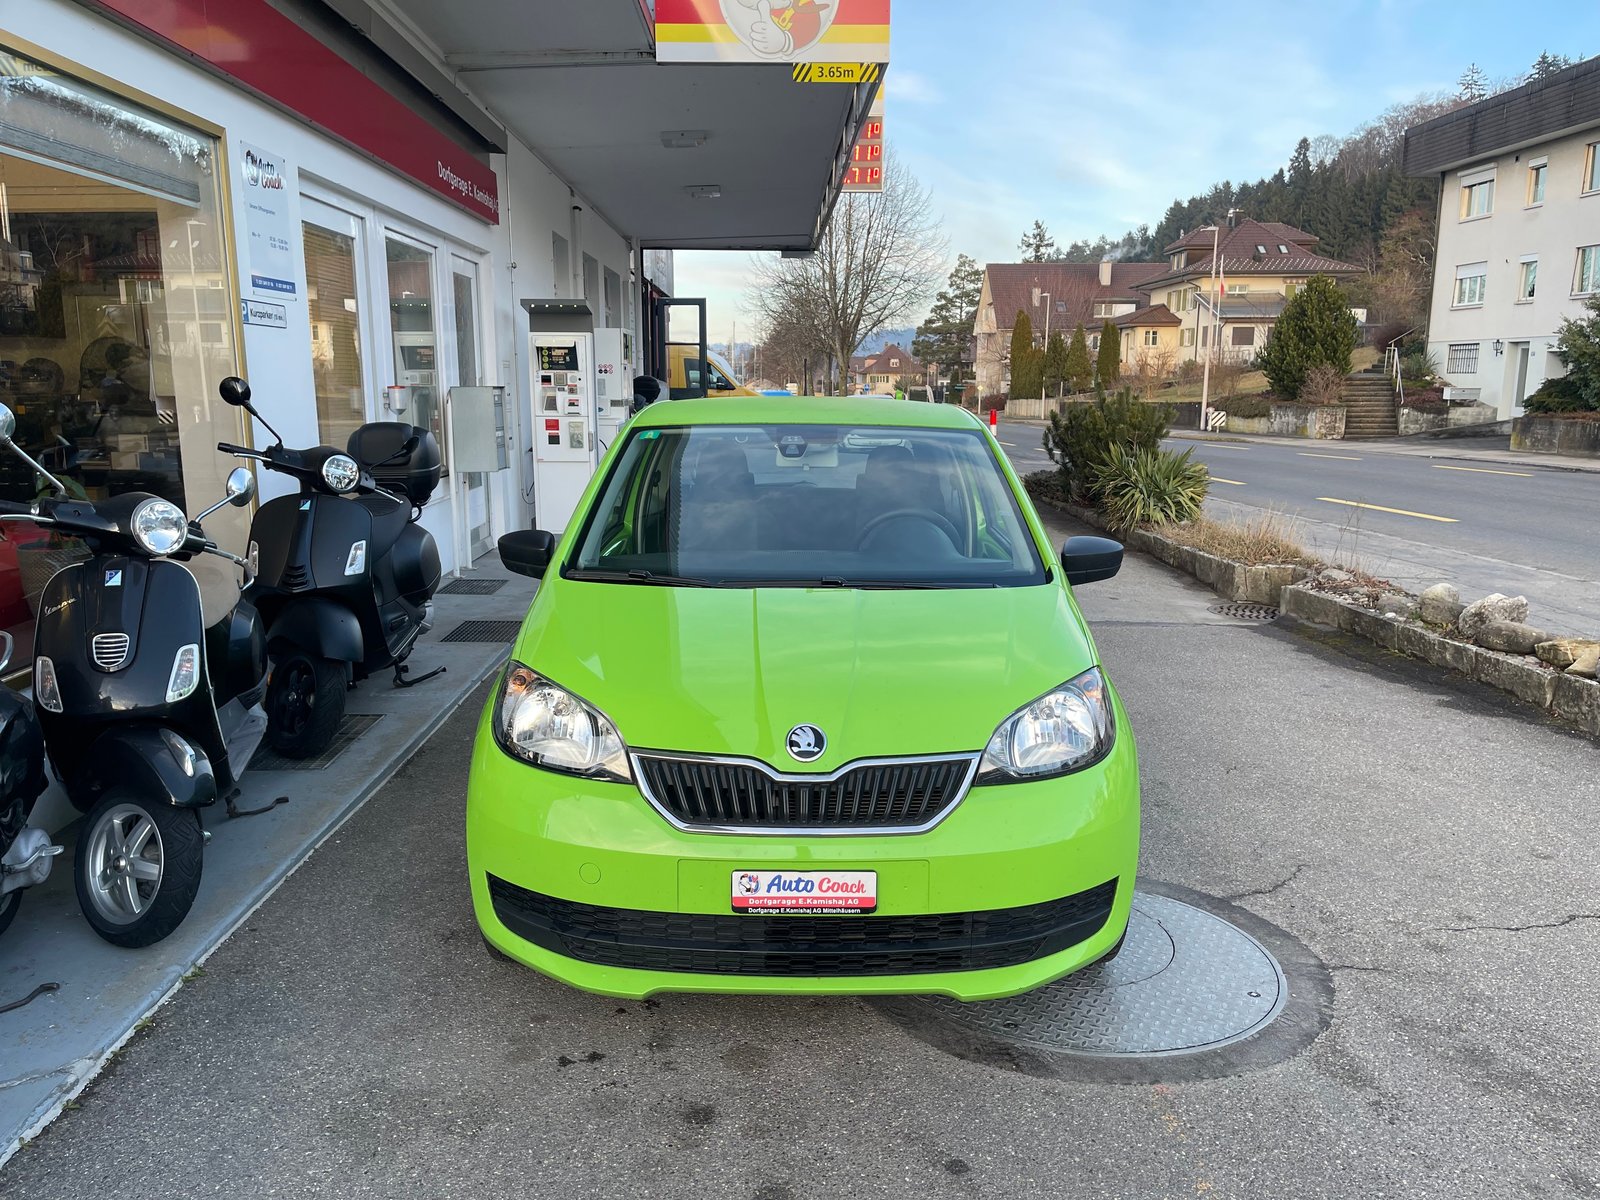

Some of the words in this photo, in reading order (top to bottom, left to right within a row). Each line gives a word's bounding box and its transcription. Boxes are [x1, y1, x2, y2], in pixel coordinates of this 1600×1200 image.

[817, 66, 854, 78] 3.65m
[258, 158, 275, 176] Auto
[261, 172, 283, 190] Coach
[438, 160, 468, 196] Dorfgarage
[766, 874, 815, 894] Auto
[818, 877, 867, 894] Coach
[748, 898, 797, 906] Dorfgarage
[798, 898, 846, 906] E.Kamishaj
